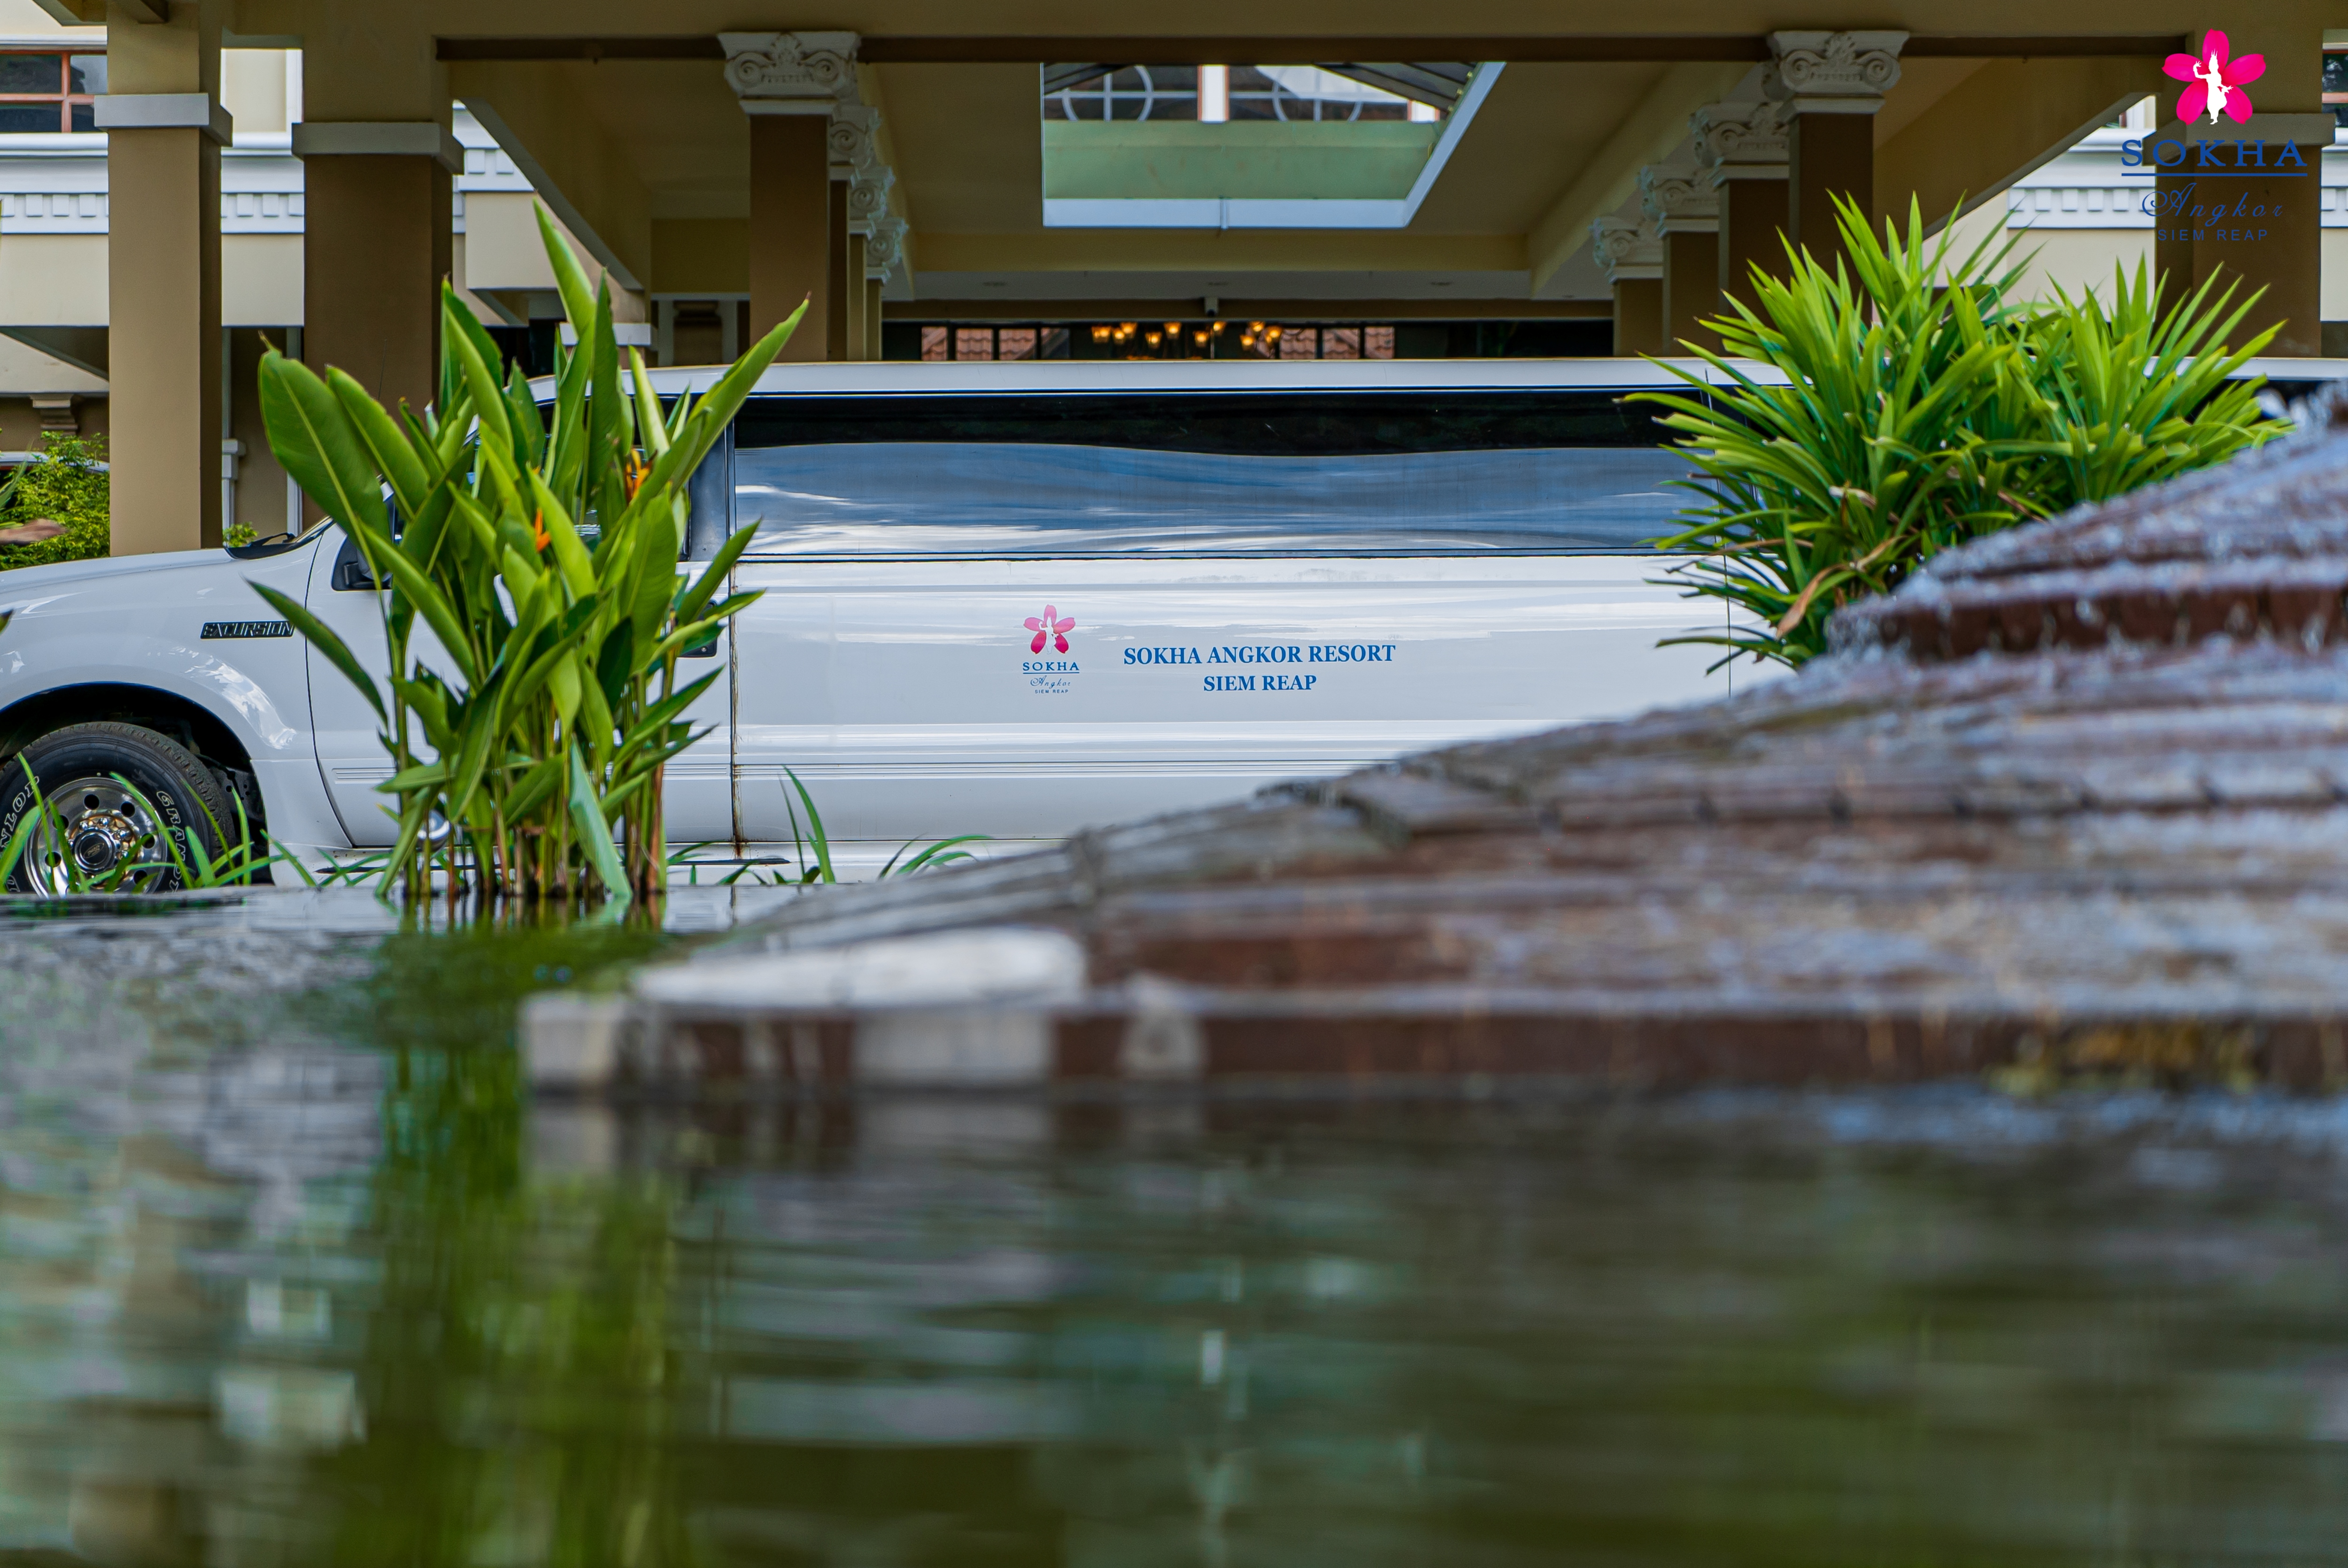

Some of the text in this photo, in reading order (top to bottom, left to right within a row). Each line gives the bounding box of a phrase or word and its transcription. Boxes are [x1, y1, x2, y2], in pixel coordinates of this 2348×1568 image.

[204, 622, 294, 637] EXCURSION
[1124, 645, 1396, 665] SOKHA ANGKOR RESORT
[1022, 661, 1080, 671] SOKHA
[1030, 675, 1071, 689] Angkor
[1204, 675, 1317, 691] SIEM REAP
